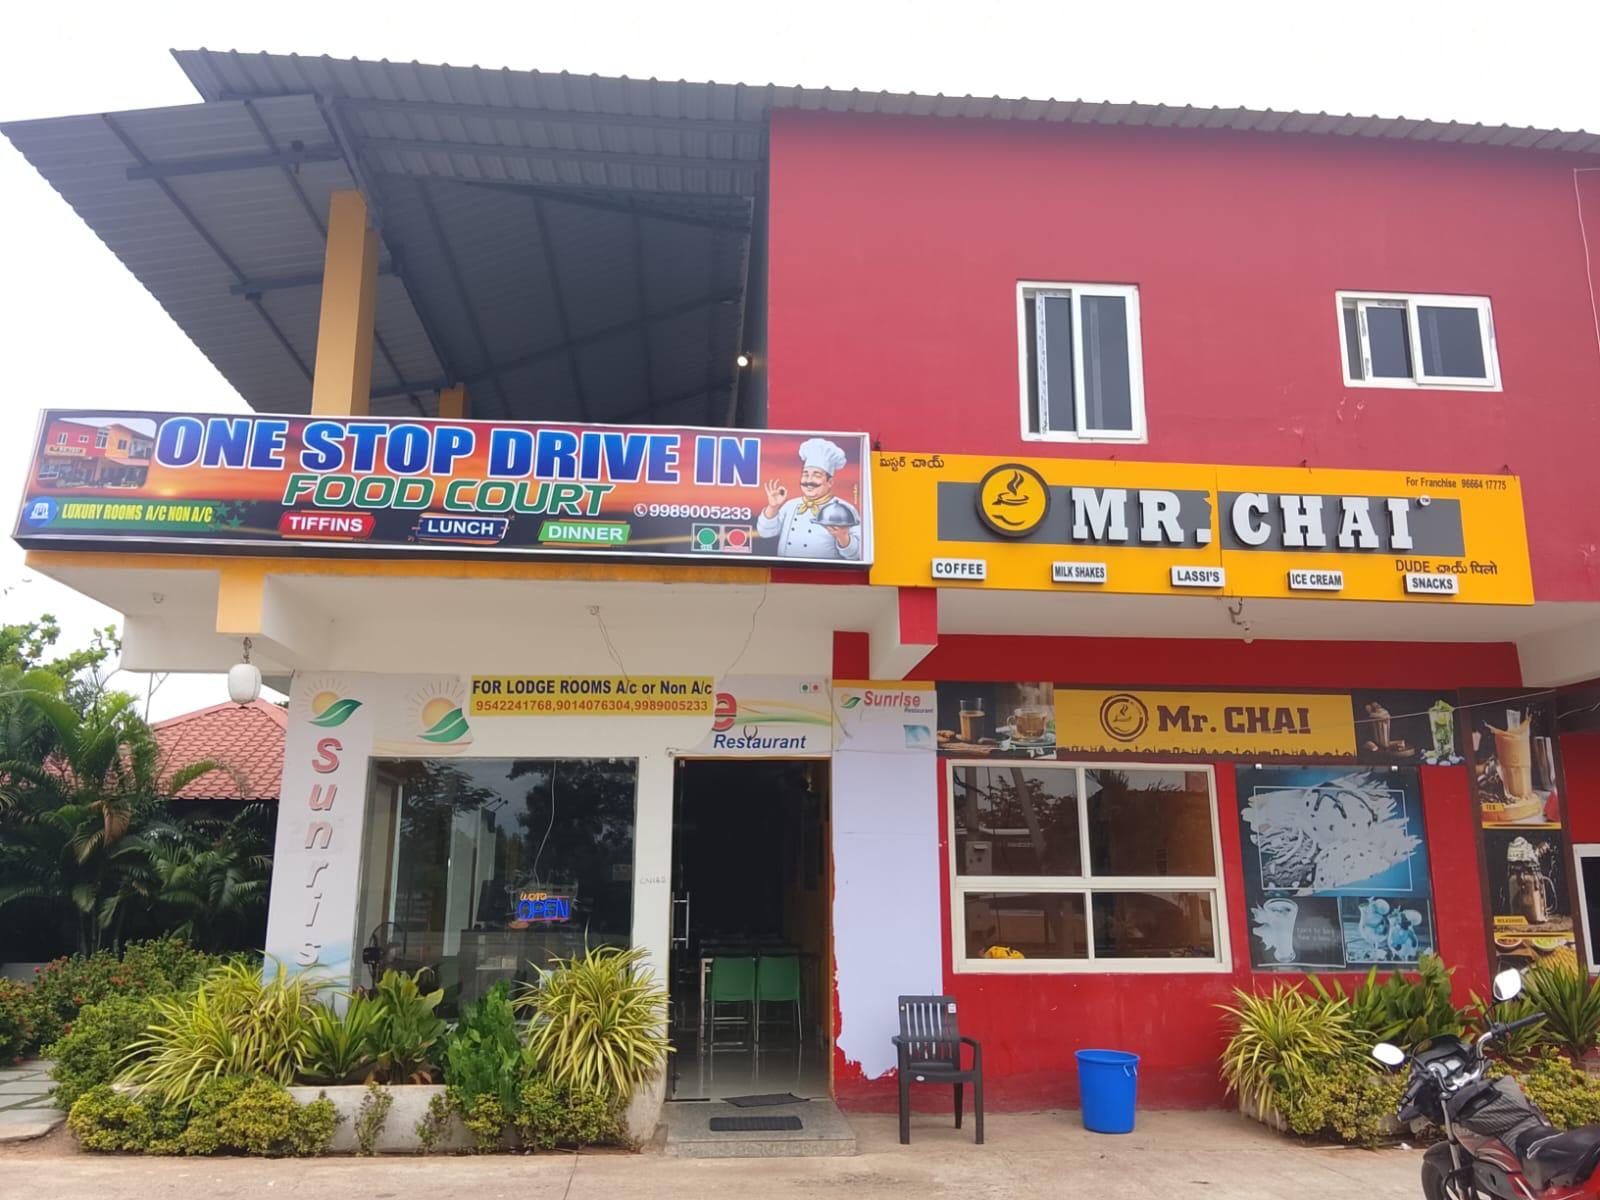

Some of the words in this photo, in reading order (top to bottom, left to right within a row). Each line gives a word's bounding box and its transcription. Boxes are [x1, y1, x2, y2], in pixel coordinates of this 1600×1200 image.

[155, 416, 289, 470] ONE
[301, 421, 475, 476] STOP
[489, 428, 681, 484] DRIVE
[694, 435, 761, 487] IN
[1406, 477, 1418, 487] For
[1421, 477, 1456, 488] Franchise
[1486, 479, 1507, 490] 17775
[282, 473, 435, 510] FOOD
[445, 479, 615, 516] COURT
[62, 504, 102, 519] LUXURY
[103, 504, 143, 520] ROOMS
[145, 505, 167, 521] A/C
[168, 505, 191, 522] NON
[191, 506, 213, 522] A/C
[649, 503, 752, 520] 9989005233
[1071, 486, 1212, 544] MR.
[1232, 492, 1414, 549] CHAI
[289, 515, 363, 533] TIFFINS
[427, 519, 494, 535] LUNCH
[548, 525, 623, 541] DINNER
[936, 561, 983, 576] COFFEE
[1054, 566, 1073, 578] MILK
[1075, 566, 1105, 579] SHAKES
[1396, 559, 1431, 573] DUDE
[1177, 569, 1220, 583] LASSI'S
[1292, 573, 1308, 585] ICE
[1309, 574, 1342, 587] CREAM
[1412, 578, 1453, 590] SNACKS
[472, 680, 501, 694] FOR
[507, 680, 555, 694] LODGE
[560, 680, 611, 694] ROOMS
[615, 680, 637, 695] A/c
[642, 683, 656, 694] or
[660, 680, 686, 695] Non
[691, 681, 713, 695] A/c
[863, 690, 921, 707] Sunrise
[1157, 705, 1217, 733] Mr.
[1224, 706, 1311, 734] CHAI
[714, 734, 806, 750] Restaurant
[518, 899, 569, 920] OPEN
